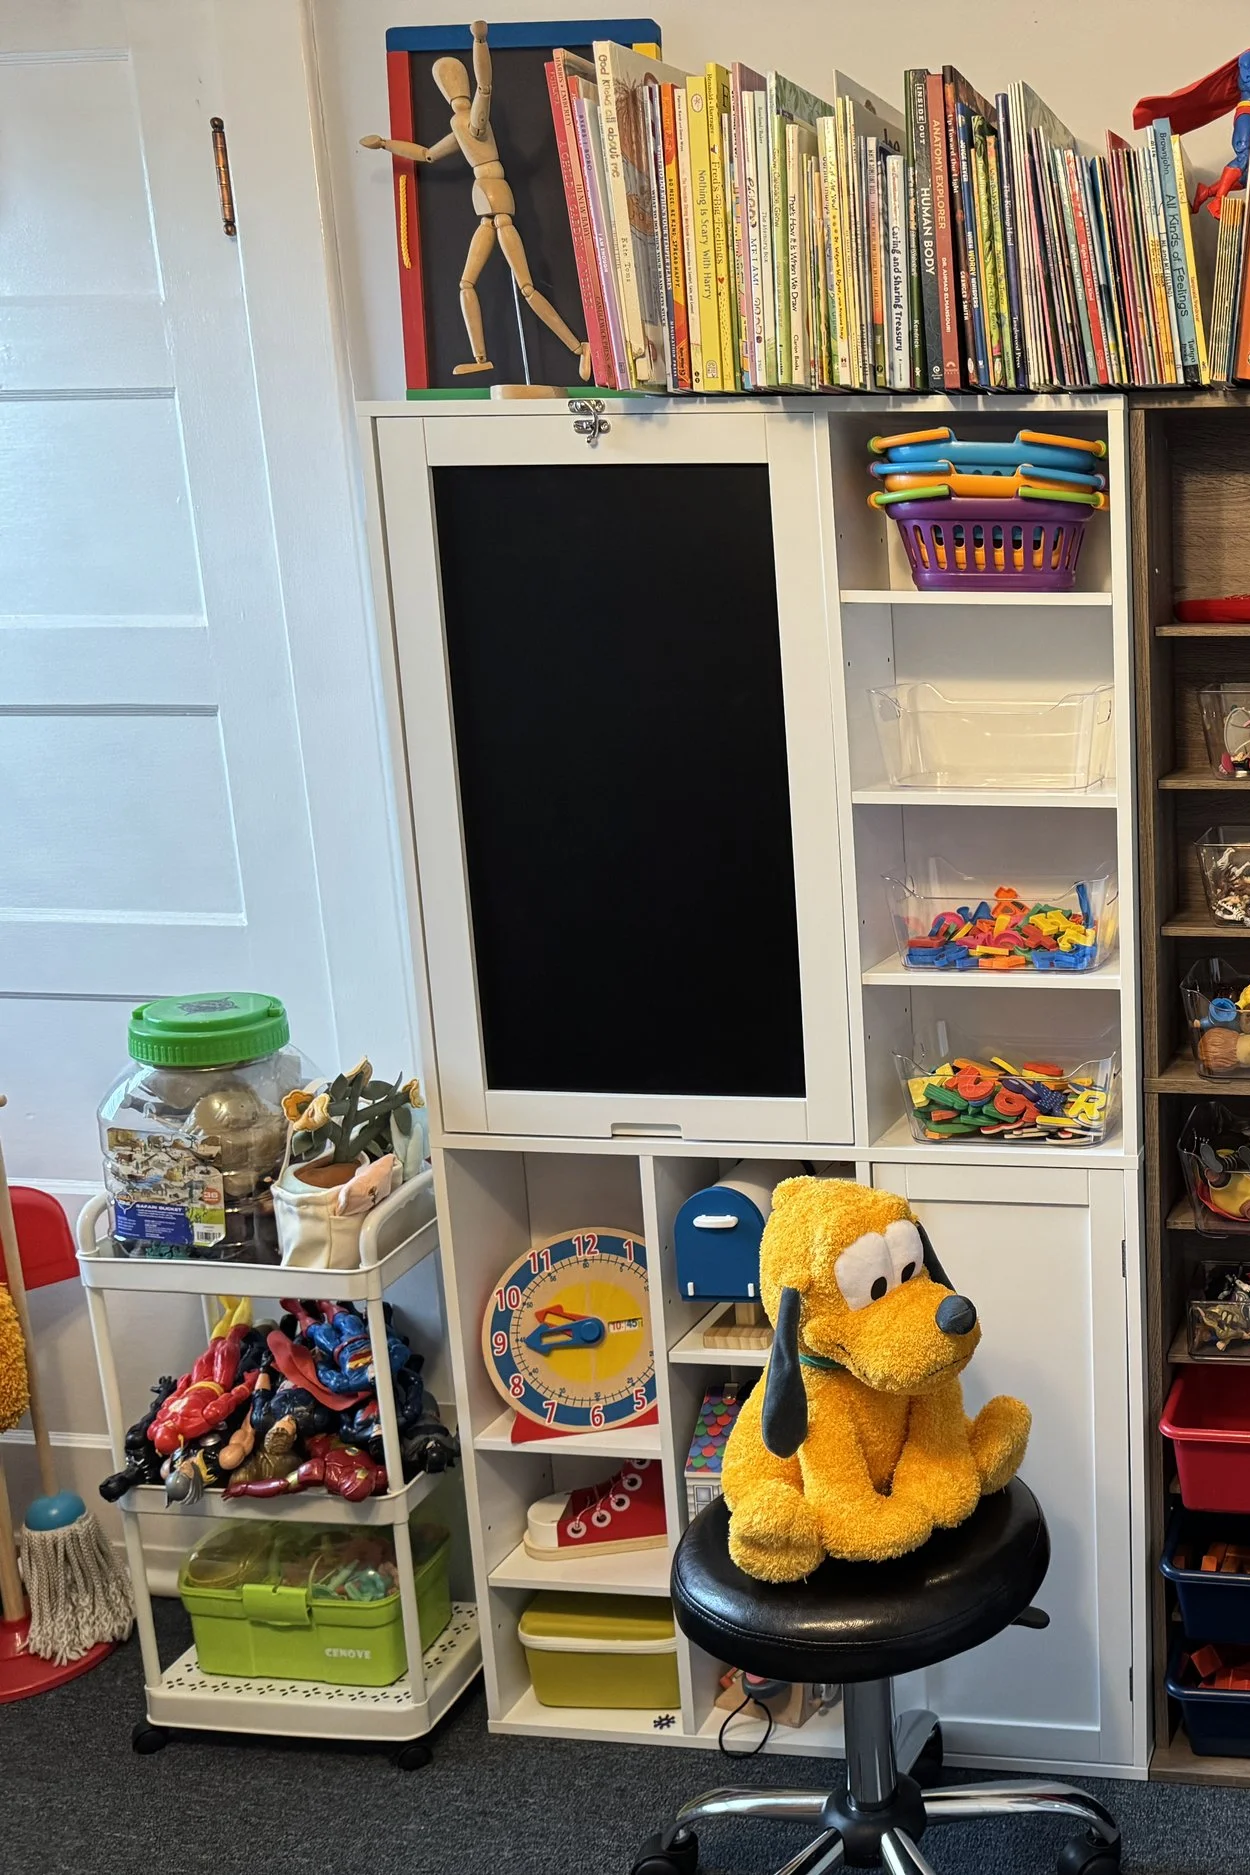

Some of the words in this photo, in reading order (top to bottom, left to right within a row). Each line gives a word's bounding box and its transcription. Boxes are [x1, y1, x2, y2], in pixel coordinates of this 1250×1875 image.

[556, 57, 567, 83] HARRIS
[598, 54, 610, 75] God
[602, 79, 612, 106] knows
[916, 86, 924, 121] INSIDE
[560, 89, 572, 127] EMBERLEY
[605, 110, 616, 123] all
[946, 114, 953, 125] Up
[579, 114, 590, 138] BYERS
[608, 127, 620, 159] about
[931, 119, 943, 171] ANATOMY
[948, 128, 956, 155] Toward
[1158, 132, 1171, 174] Brownjohn
[584, 148, 593, 171] BOBO
[612, 162, 621, 178] me
[695, 169, 707, 205] Nothing
[711, 161, 720, 191] Fred's
[951, 173, 959, 193] Light
[561, 152, 575, 199] CHILD'S
[569, 204, 583, 251] GARDEN
[578, 196, 588, 214] NEW
[711, 194, 721, 217] Big
[920, 187, 932, 236] HUMAN
[934, 174, 947, 229] EXPLORER
[1003, 200, 1012, 226] Kissing
[1165, 193, 1176, 209] All
[698, 218, 709, 245] Scary
[713, 218, 724, 264] Feelings
[891, 226, 901, 254] Caring
[1167, 214, 1181, 247] Kinds
[600, 247, 608, 273] ENOUGH
[621, 237, 629, 257] Kate
[702, 249, 711, 268] With
[923, 240, 935, 275] BODY
[1172, 251, 1182, 263] of
[893, 256, 902, 273] and
[968, 250, 976, 276] WORRY
[701, 272, 712, 300] Harry
[791, 277, 798, 289] We
[893, 275, 903, 309] Sharing
[959, 270, 967, 298] GRANGER
[1164, 273, 1173, 298] FEELINGS
[1172, 266, 1190, 317] Feelings
[943, 292, 951, 332] ELMANSOURI
[595, 296, 607, 340] CANDLEWICK
[602, 341, 611, 361] PRESS
[894, 311, 904, 351] Treasury
[911, 319, 920, 348] Kendrick
[1011, 315, 1020, 350] Tanglewood
[1186, 339, 1196, 363] Tango
[572, 1233, 598, 1257] 12
[623, 1239, 634, 1262] 1
[528, 1249, 551, 1274] 11
[494, 1286, 521, 1311] 10
[627, 1320, 637, 1329] 45
[493, 1332, 508, 1356] 9
[509, 1374, 525, 1398] 8
[633, 1387, 647, 1411] 5
[543, 1400, 557, 1425] 7
[590, 1404, 605, 1428] 6
[325, 1647, 372, 1660] CENOVE
